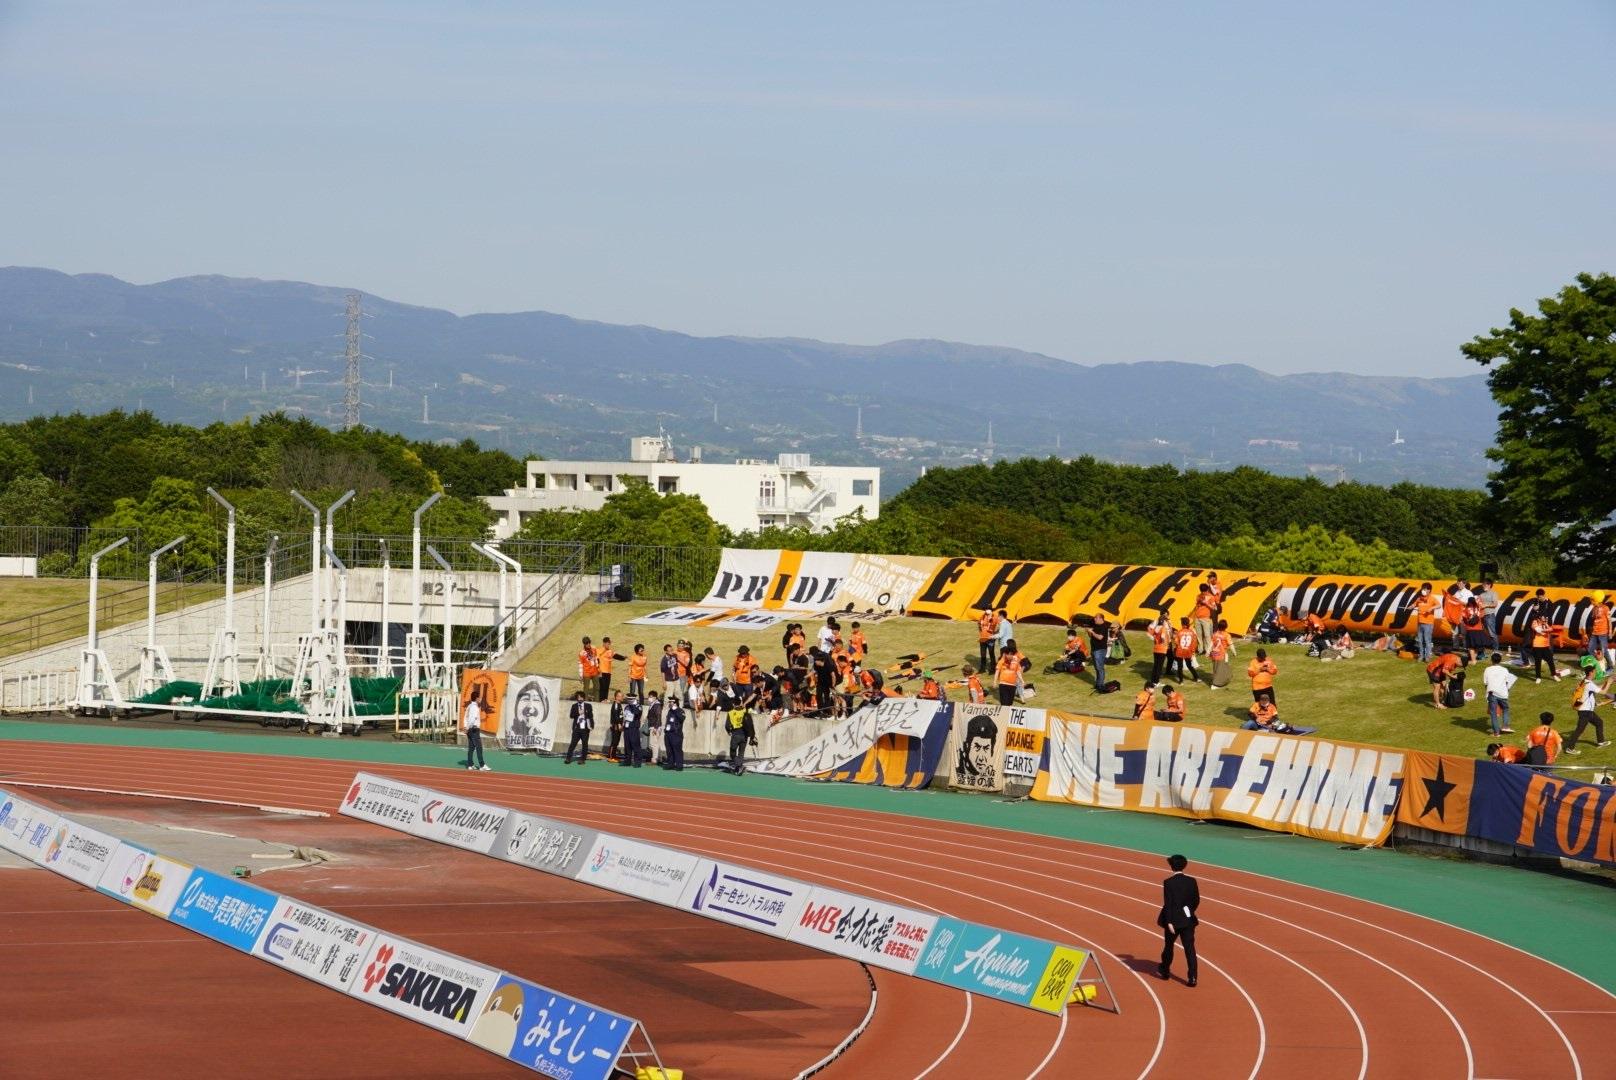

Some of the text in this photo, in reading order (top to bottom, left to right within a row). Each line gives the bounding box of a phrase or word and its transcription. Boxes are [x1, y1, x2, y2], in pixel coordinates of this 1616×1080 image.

[713, 571, 843, 604] PRIDE
[1290, 576, 1422, 630] Lovely
[961, 702, 1001, 717] Vamos!!
[1010, 708, 1026, 725] THE
[1006, 731, 1035, 750] ORANGE
[1046, 715, 1405, 841] WE ARE EHIME
[437, 805, 504, 834] KURUMAYA
[953, 933, 1030, 981] Aquino
[379, 962, 478, 1025] SAKURA
[981, 973, 1033, 996] management
[523, 1009, 612, 1065] みとしー
